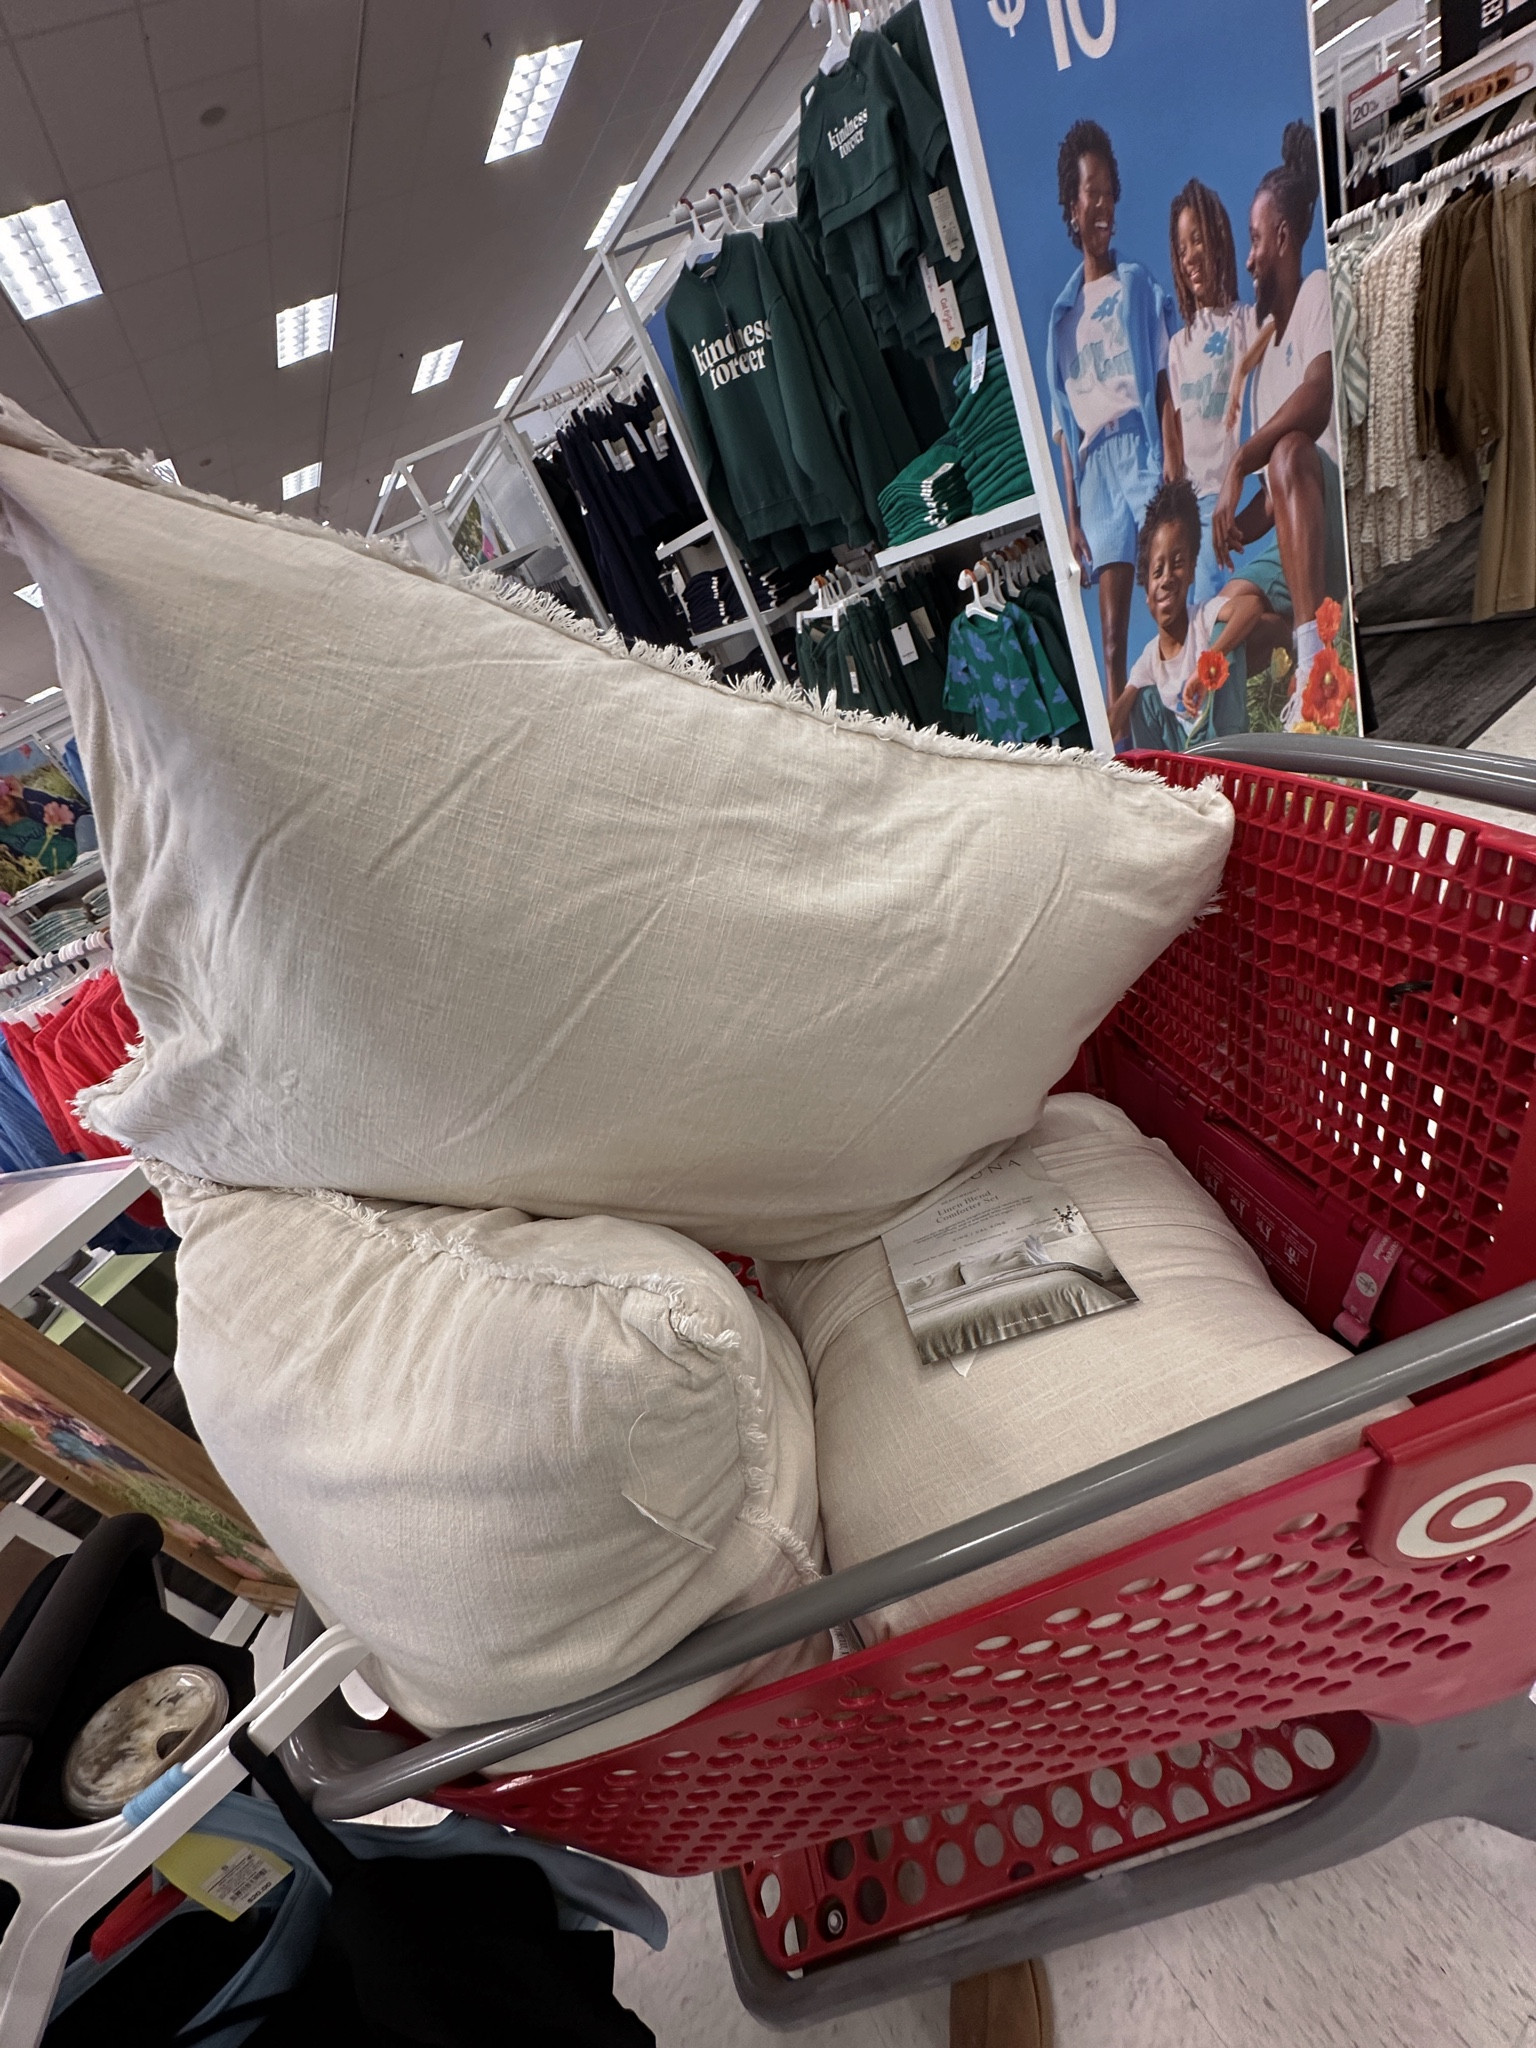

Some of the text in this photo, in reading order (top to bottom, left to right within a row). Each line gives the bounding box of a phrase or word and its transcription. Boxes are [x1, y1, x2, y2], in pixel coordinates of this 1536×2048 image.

[827, 107, 868, 151] kindness
[709, 346, 767, 391] foreer
[935, 1194, 1000, 1224] Comforter Set
[937, 1190, 992, 1217] Linen Blend
